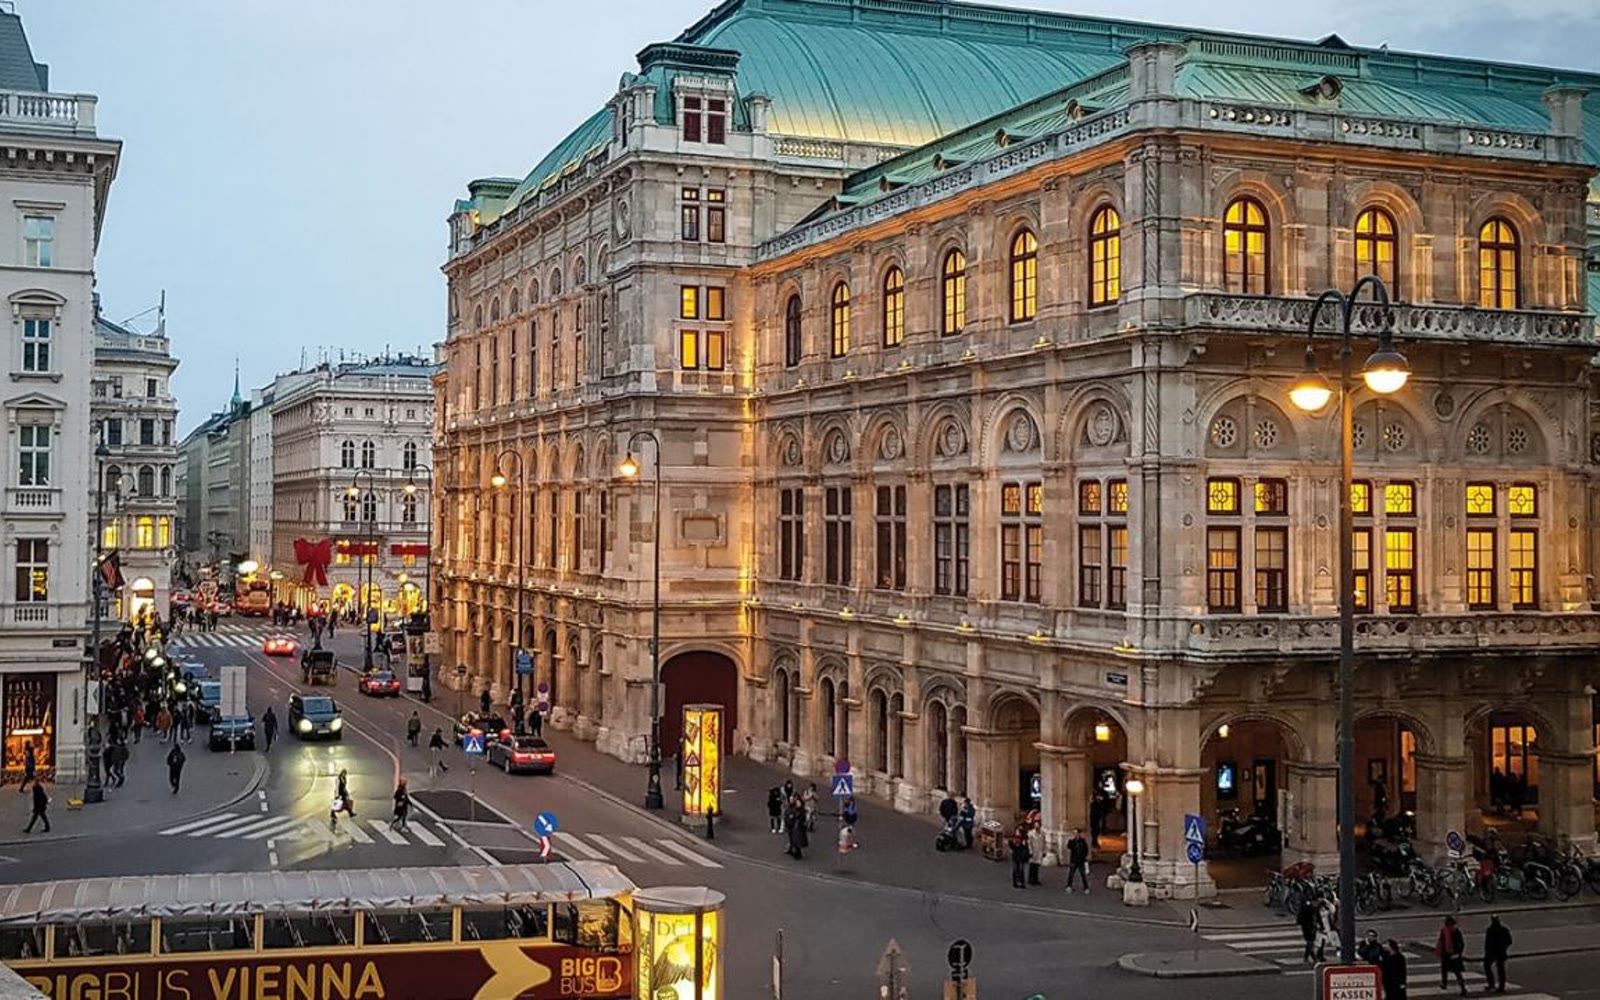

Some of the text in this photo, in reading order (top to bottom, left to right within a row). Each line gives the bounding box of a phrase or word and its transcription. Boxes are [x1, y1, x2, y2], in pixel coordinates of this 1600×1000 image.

[561, 958, 595, 976] BIG
[208, 961, 385, 1000] VIENNA
[560, 977, 595, 995] BUS
[1332, 989, 1374, 1000] KASSEN
